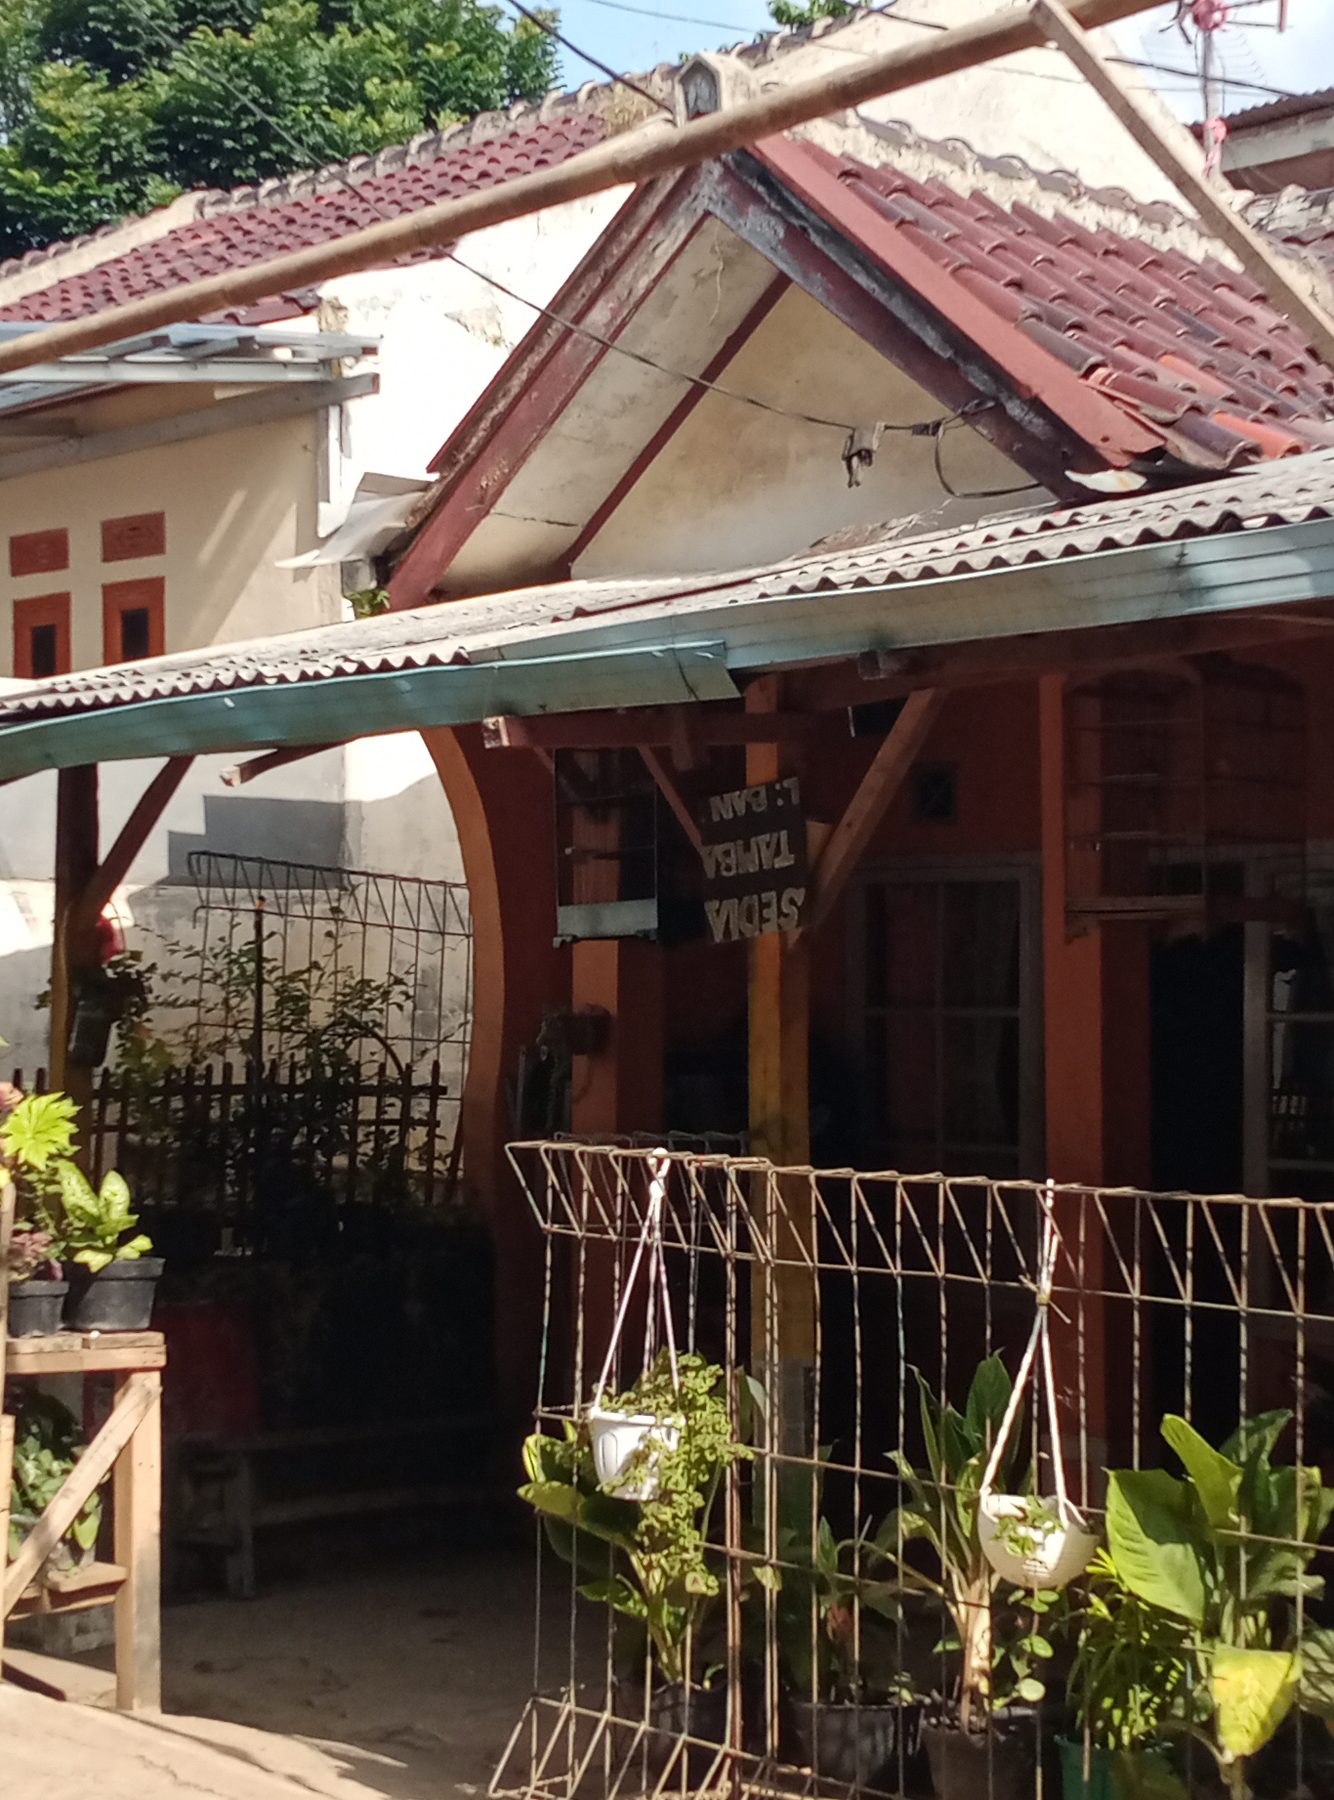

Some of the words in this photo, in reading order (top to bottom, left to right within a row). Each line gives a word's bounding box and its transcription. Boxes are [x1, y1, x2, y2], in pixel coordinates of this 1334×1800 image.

[710, 786, 767, 822] BAN
[700, 830, 795, 879] TAMBA
[705, 888, 805, 942] SEDIA
